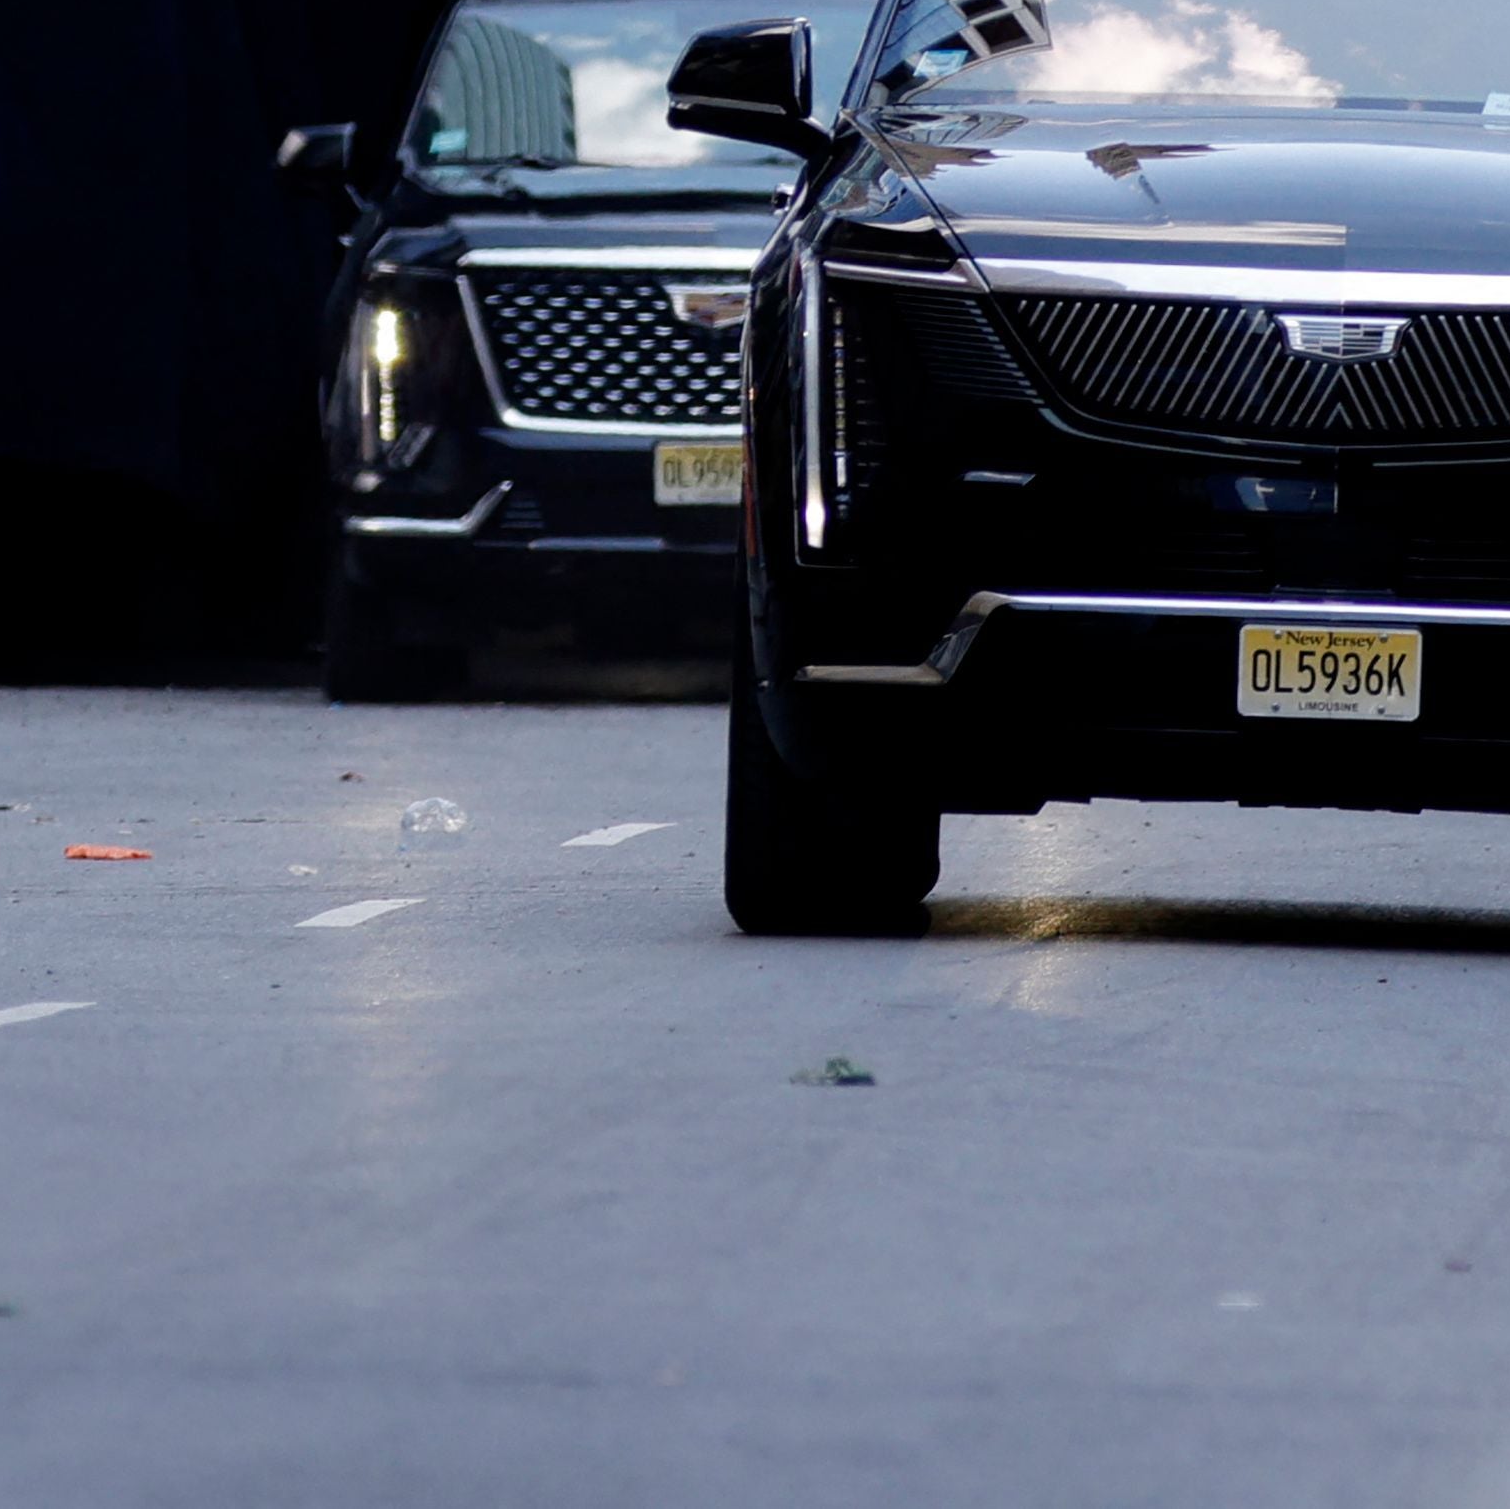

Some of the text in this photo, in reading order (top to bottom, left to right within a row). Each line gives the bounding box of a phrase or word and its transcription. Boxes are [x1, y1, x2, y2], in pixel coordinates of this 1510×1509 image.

[1286, 630, 1376, 651] New Jersey
[1253, 650, 1406, 696] OL5936K
[1298, 701, 1359, 712] LIMOUSINE
